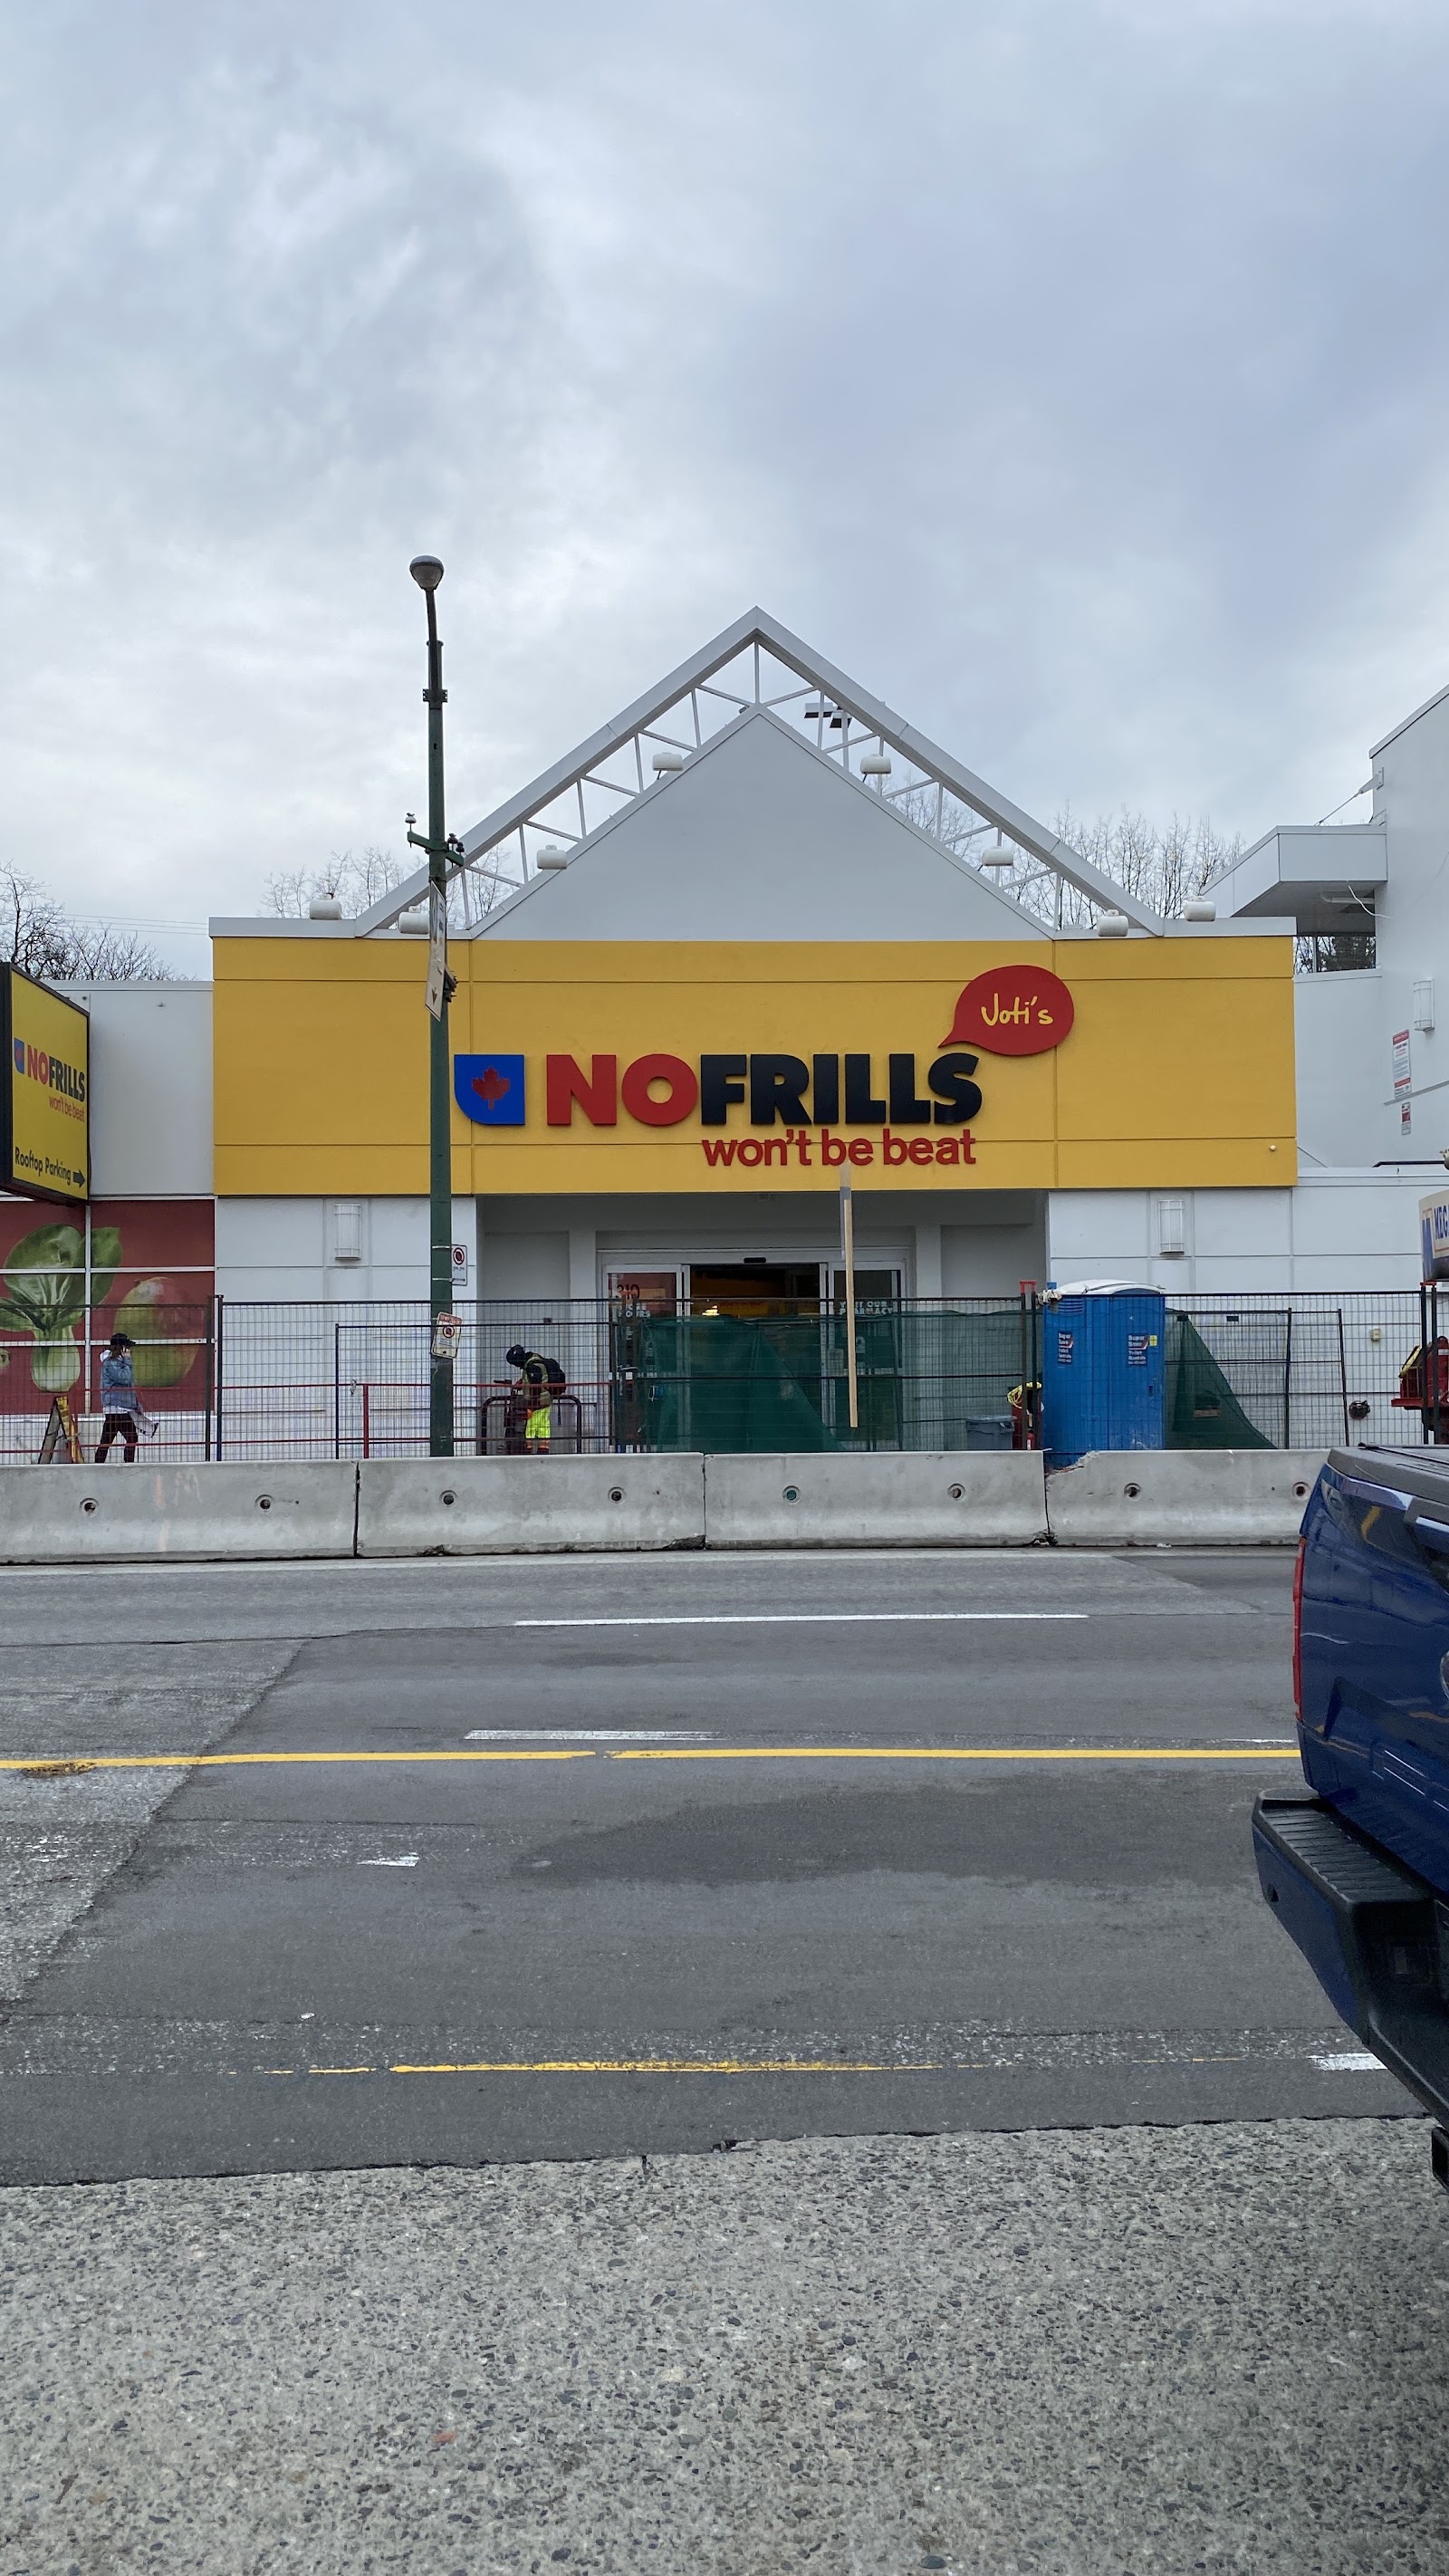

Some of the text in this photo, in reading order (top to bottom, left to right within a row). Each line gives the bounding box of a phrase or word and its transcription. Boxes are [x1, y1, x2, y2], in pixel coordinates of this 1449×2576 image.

[981, 994, 1053, 1027] Joti's
[48, 1095, 85, 1122] won't be beat
[701, 1129, 976, 1166] won't be beat
[14, 1146, 72, 1186] Rooftop Parking
[1434, 1205, 1449, 1239] MEG
